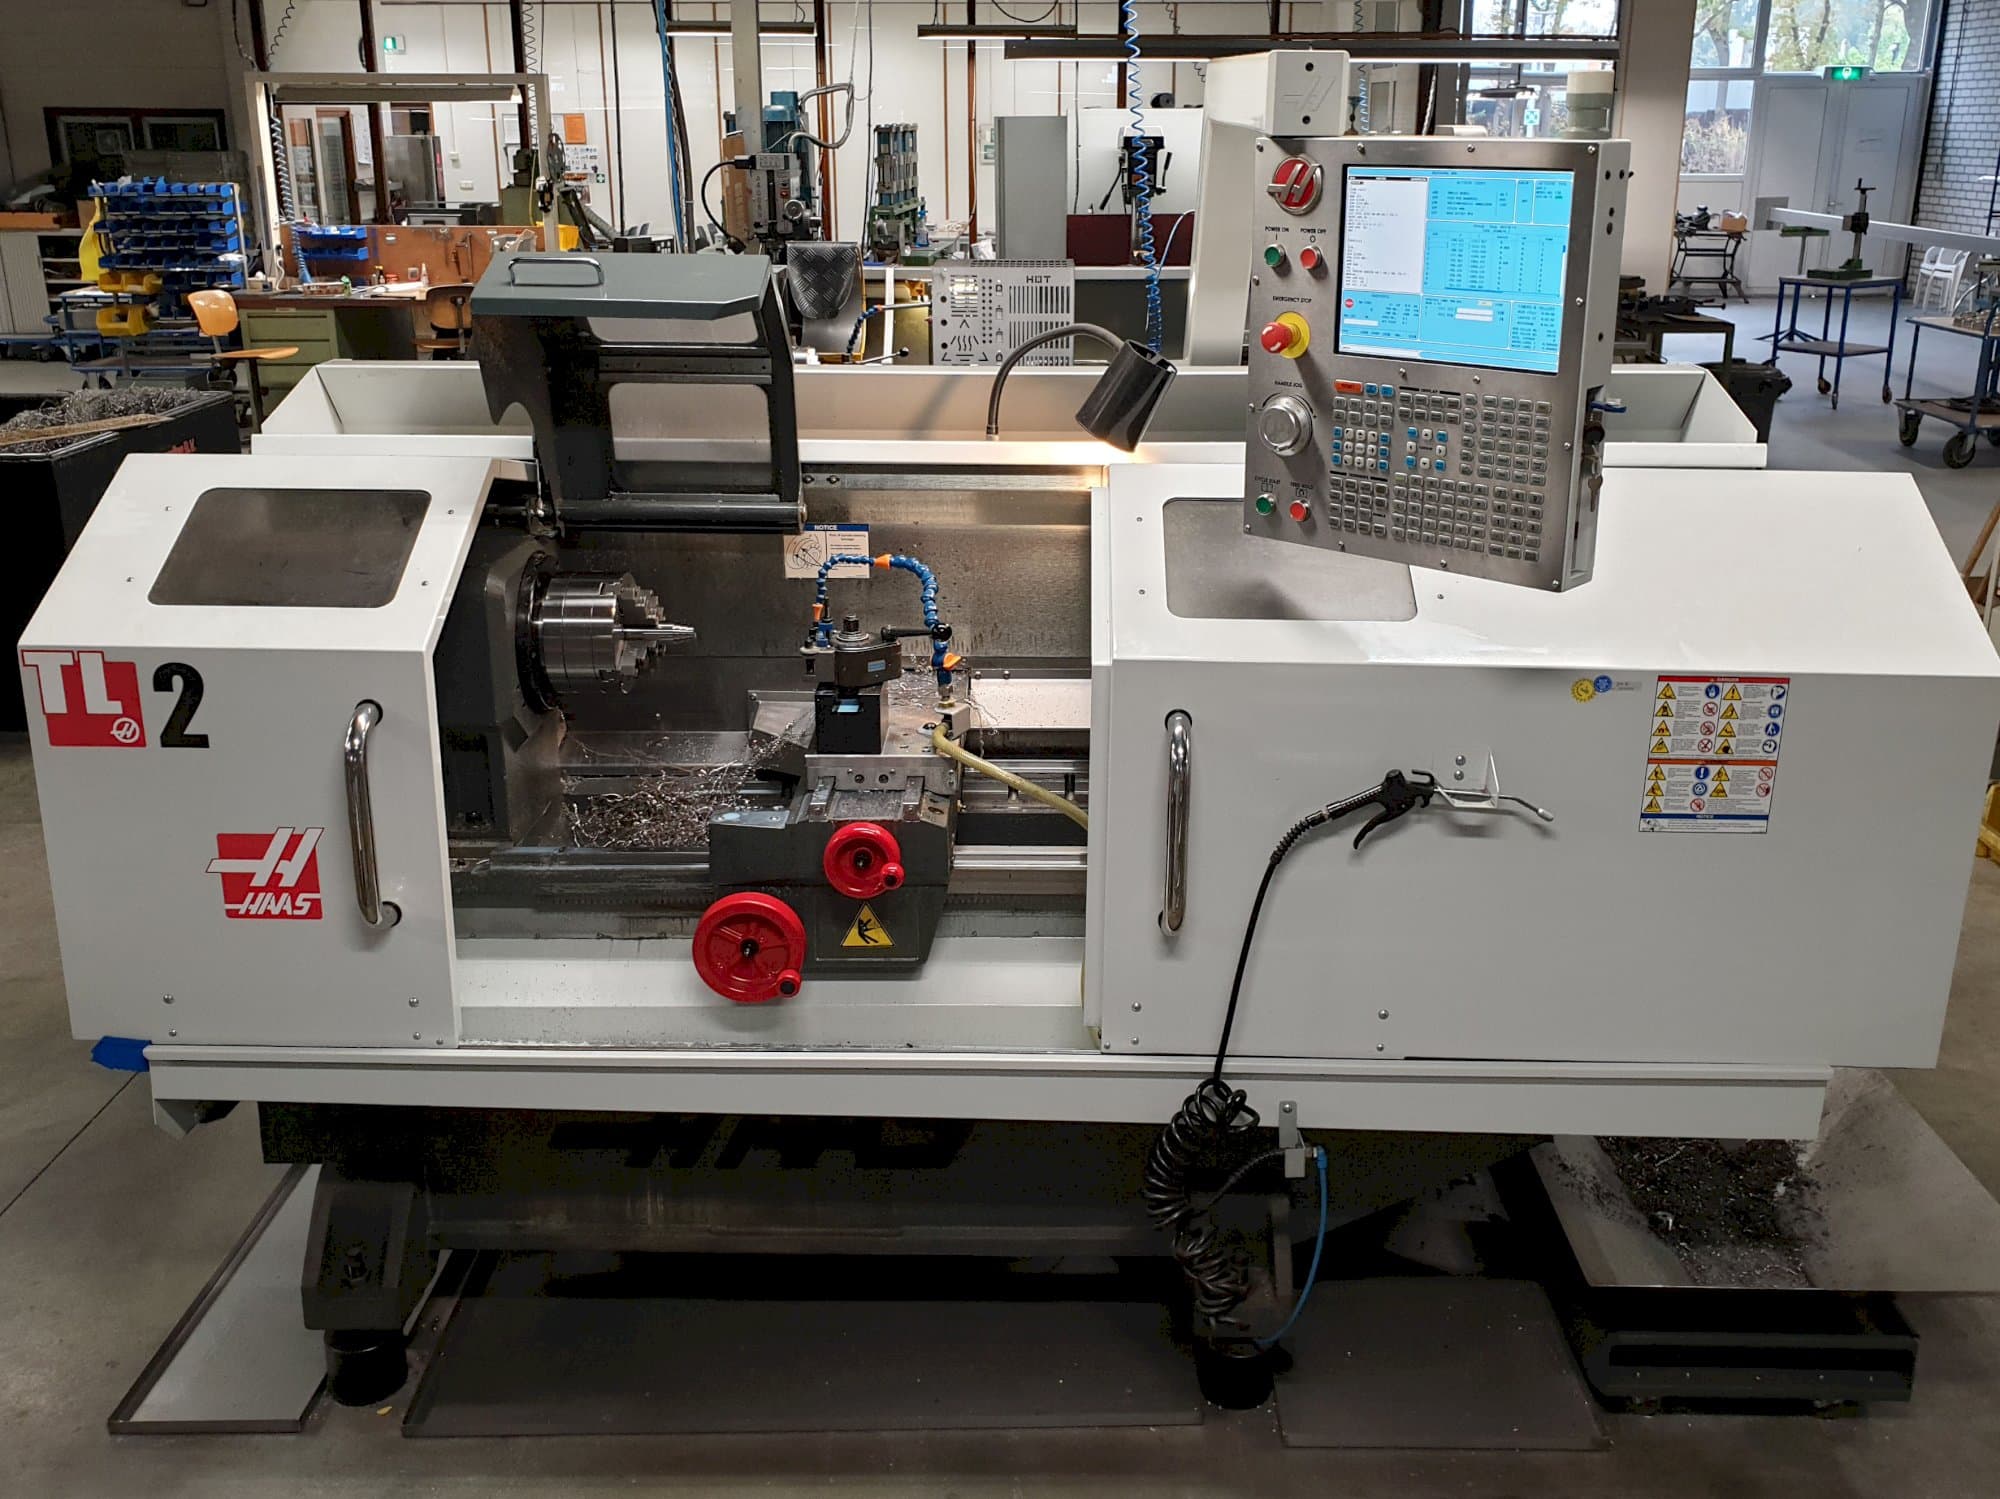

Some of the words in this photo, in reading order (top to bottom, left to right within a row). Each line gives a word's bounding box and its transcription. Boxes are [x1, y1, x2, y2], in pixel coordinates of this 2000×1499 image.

[22, 650, 123, 715] TL
[152, 661, 210, 749] 2
[224, 891, 321, 916] HAAS
